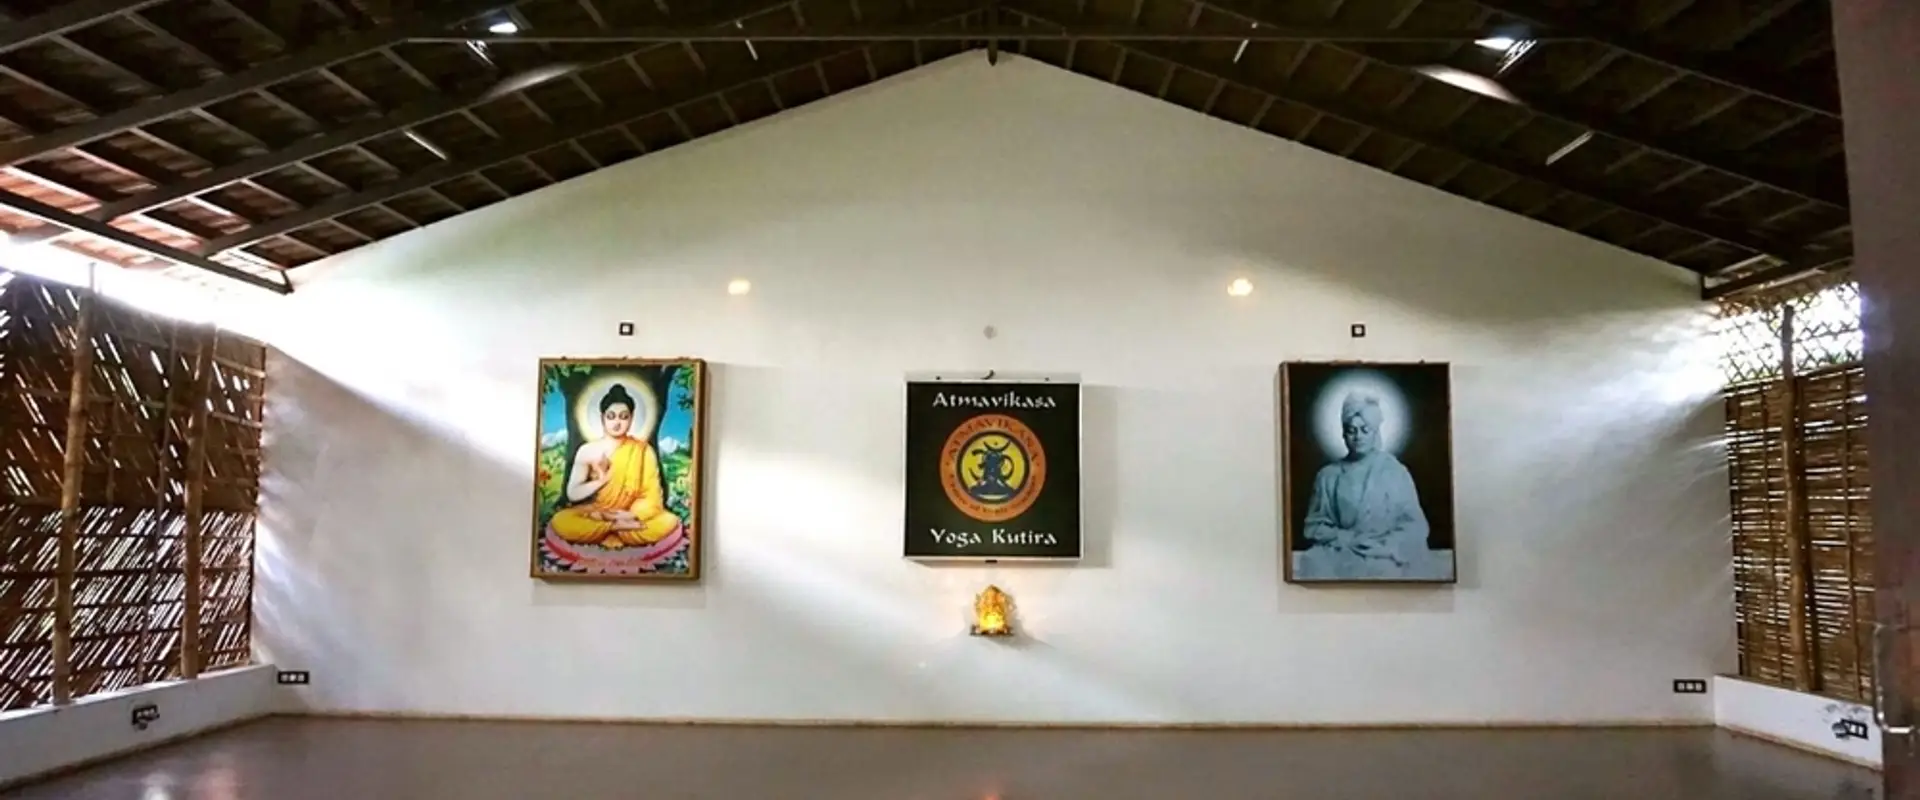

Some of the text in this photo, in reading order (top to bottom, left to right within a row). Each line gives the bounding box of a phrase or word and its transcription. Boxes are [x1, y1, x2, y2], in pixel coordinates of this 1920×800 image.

[932, 391, 1056, 408] Atmavikasa
[930, 528, 1057, 548] Yoga Kutira
